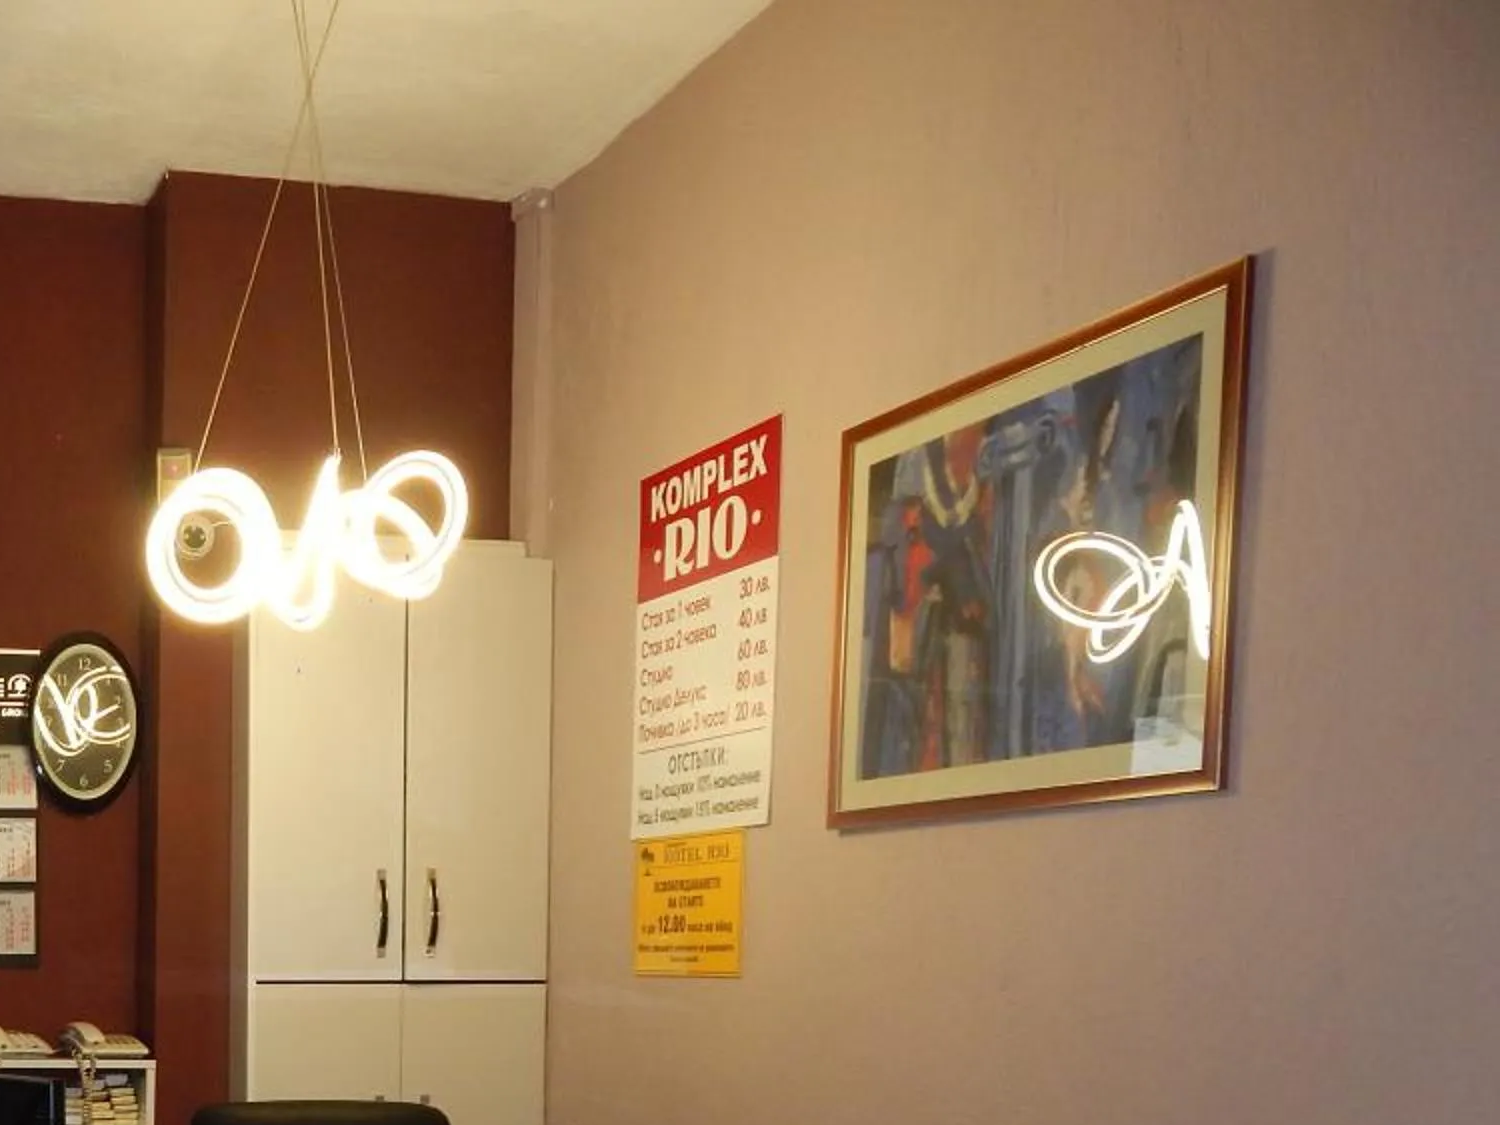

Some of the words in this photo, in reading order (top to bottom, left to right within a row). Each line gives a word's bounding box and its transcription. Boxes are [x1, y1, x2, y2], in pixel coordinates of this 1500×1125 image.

[651, 434, 768, 523] KOMPLEX
[739, 576, 753, 600] 30
[738, 607, 752, 629] 40
